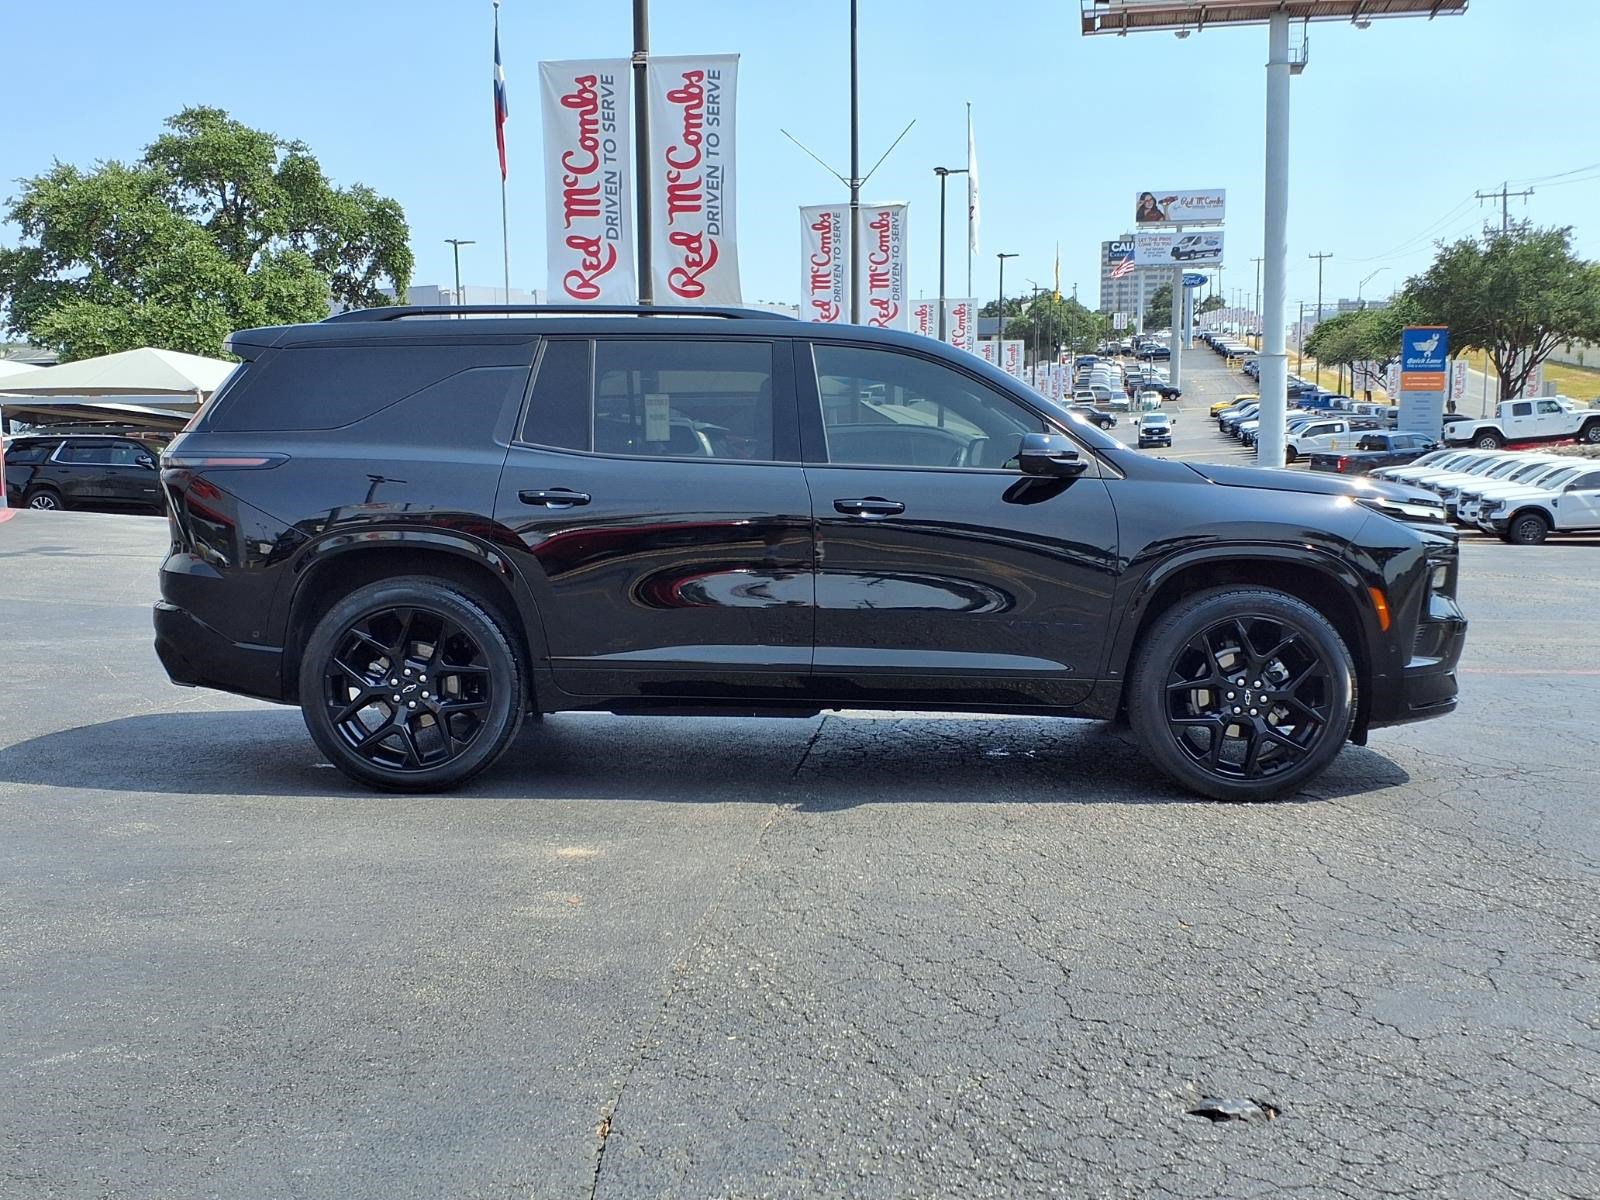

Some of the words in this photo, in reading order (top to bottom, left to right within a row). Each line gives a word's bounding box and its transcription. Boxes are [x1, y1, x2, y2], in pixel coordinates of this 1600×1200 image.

[600, 74, 615, 133] SERVE
[707, 69, 721, 127] SERVE
[560, 74, 601, 229] McCombs
[603, 138, 617, 164] TO
[665, 70, 704, 226] McCombs
[706, 132, 720, 158] TO
[604, 170, 620, 240] DRIVEN
[706, 164, 721, 236] DRIVEN
[832, 212, 841, 245] SERVE
[891, 211, 900, 242] SERVE
[563, 235, 616, 300] Red
[667, 231, 718, 298] Red
[811, 212, 832, 296] McCombs
[833, 247, 841, 261] TO
[869, 211, 890, 295] McCombs
[892, 245, 900, 259] TO
[833, 264, 842, 302] DRIVEN
[892, 262, 900, 301] DRIVEN
